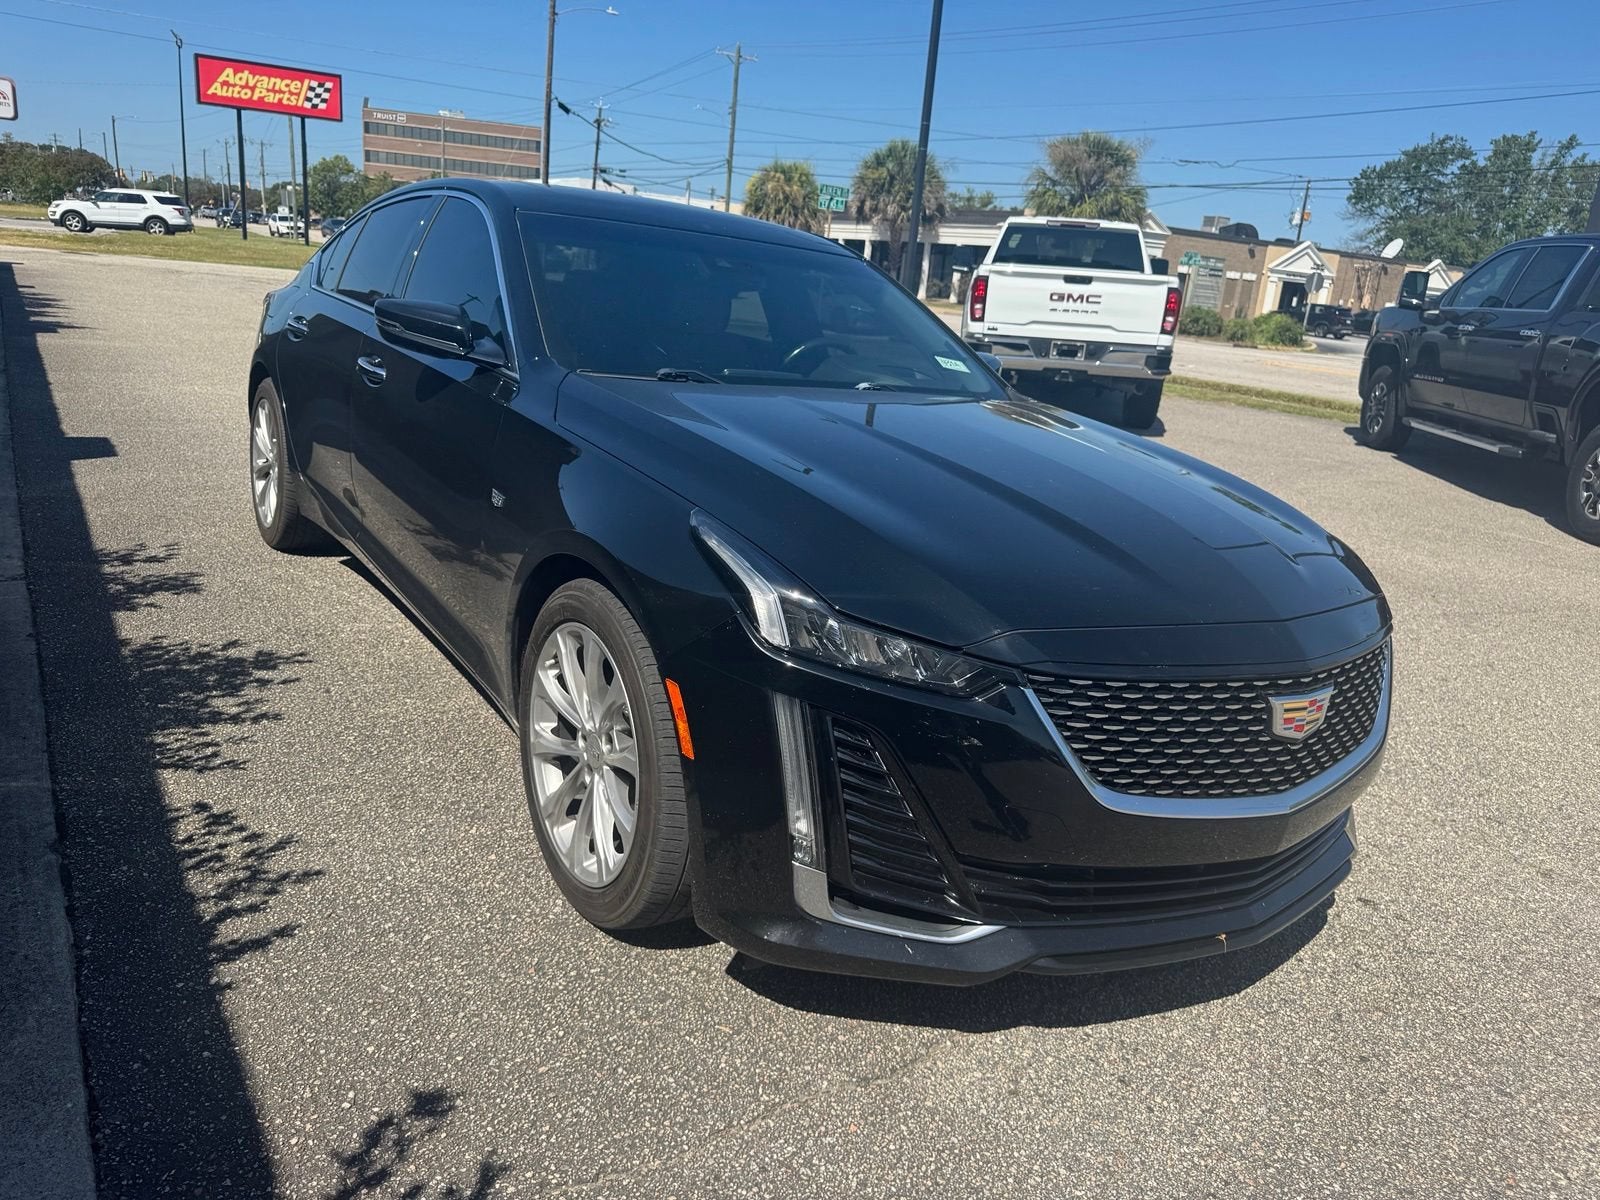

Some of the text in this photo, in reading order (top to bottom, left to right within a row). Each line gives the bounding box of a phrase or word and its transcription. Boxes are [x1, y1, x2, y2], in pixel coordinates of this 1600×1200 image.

[216, 67, 302, 93] Advance
[206, 82, 298, 106] Auto Parts
[373, 112, 396, 121] TRUIST
[1050, 292, 1102, 304] GMC
